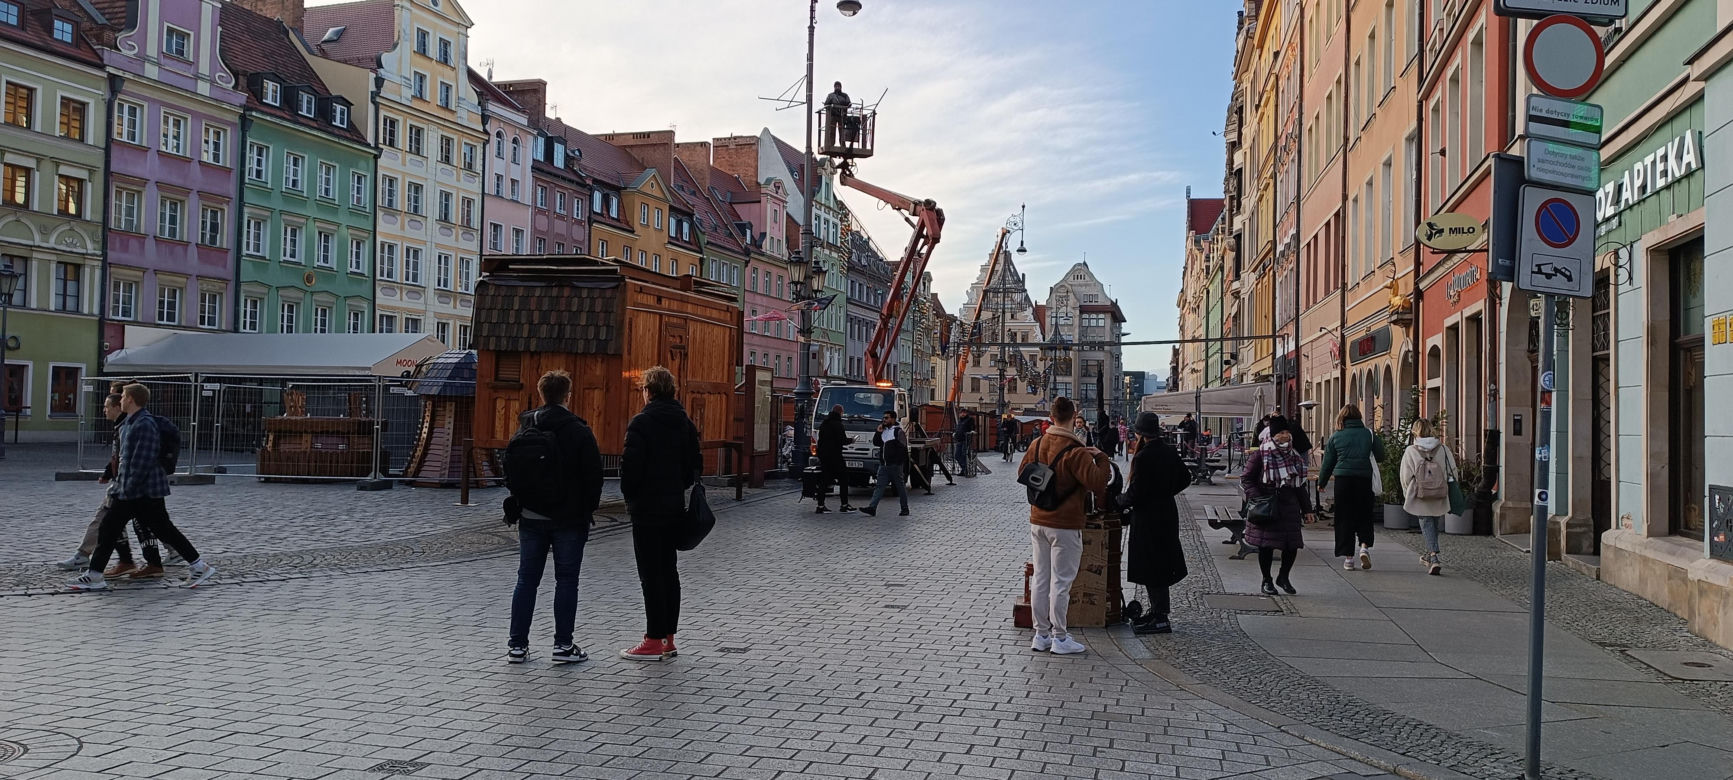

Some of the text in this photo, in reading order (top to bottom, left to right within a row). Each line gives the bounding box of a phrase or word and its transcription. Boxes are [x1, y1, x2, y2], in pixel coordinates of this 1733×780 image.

[1545, 107, 1571, 119] dotyczy
[1620, 128, 1699, 210] APTEKA
[1449, 226, 1475, 234] MILO
